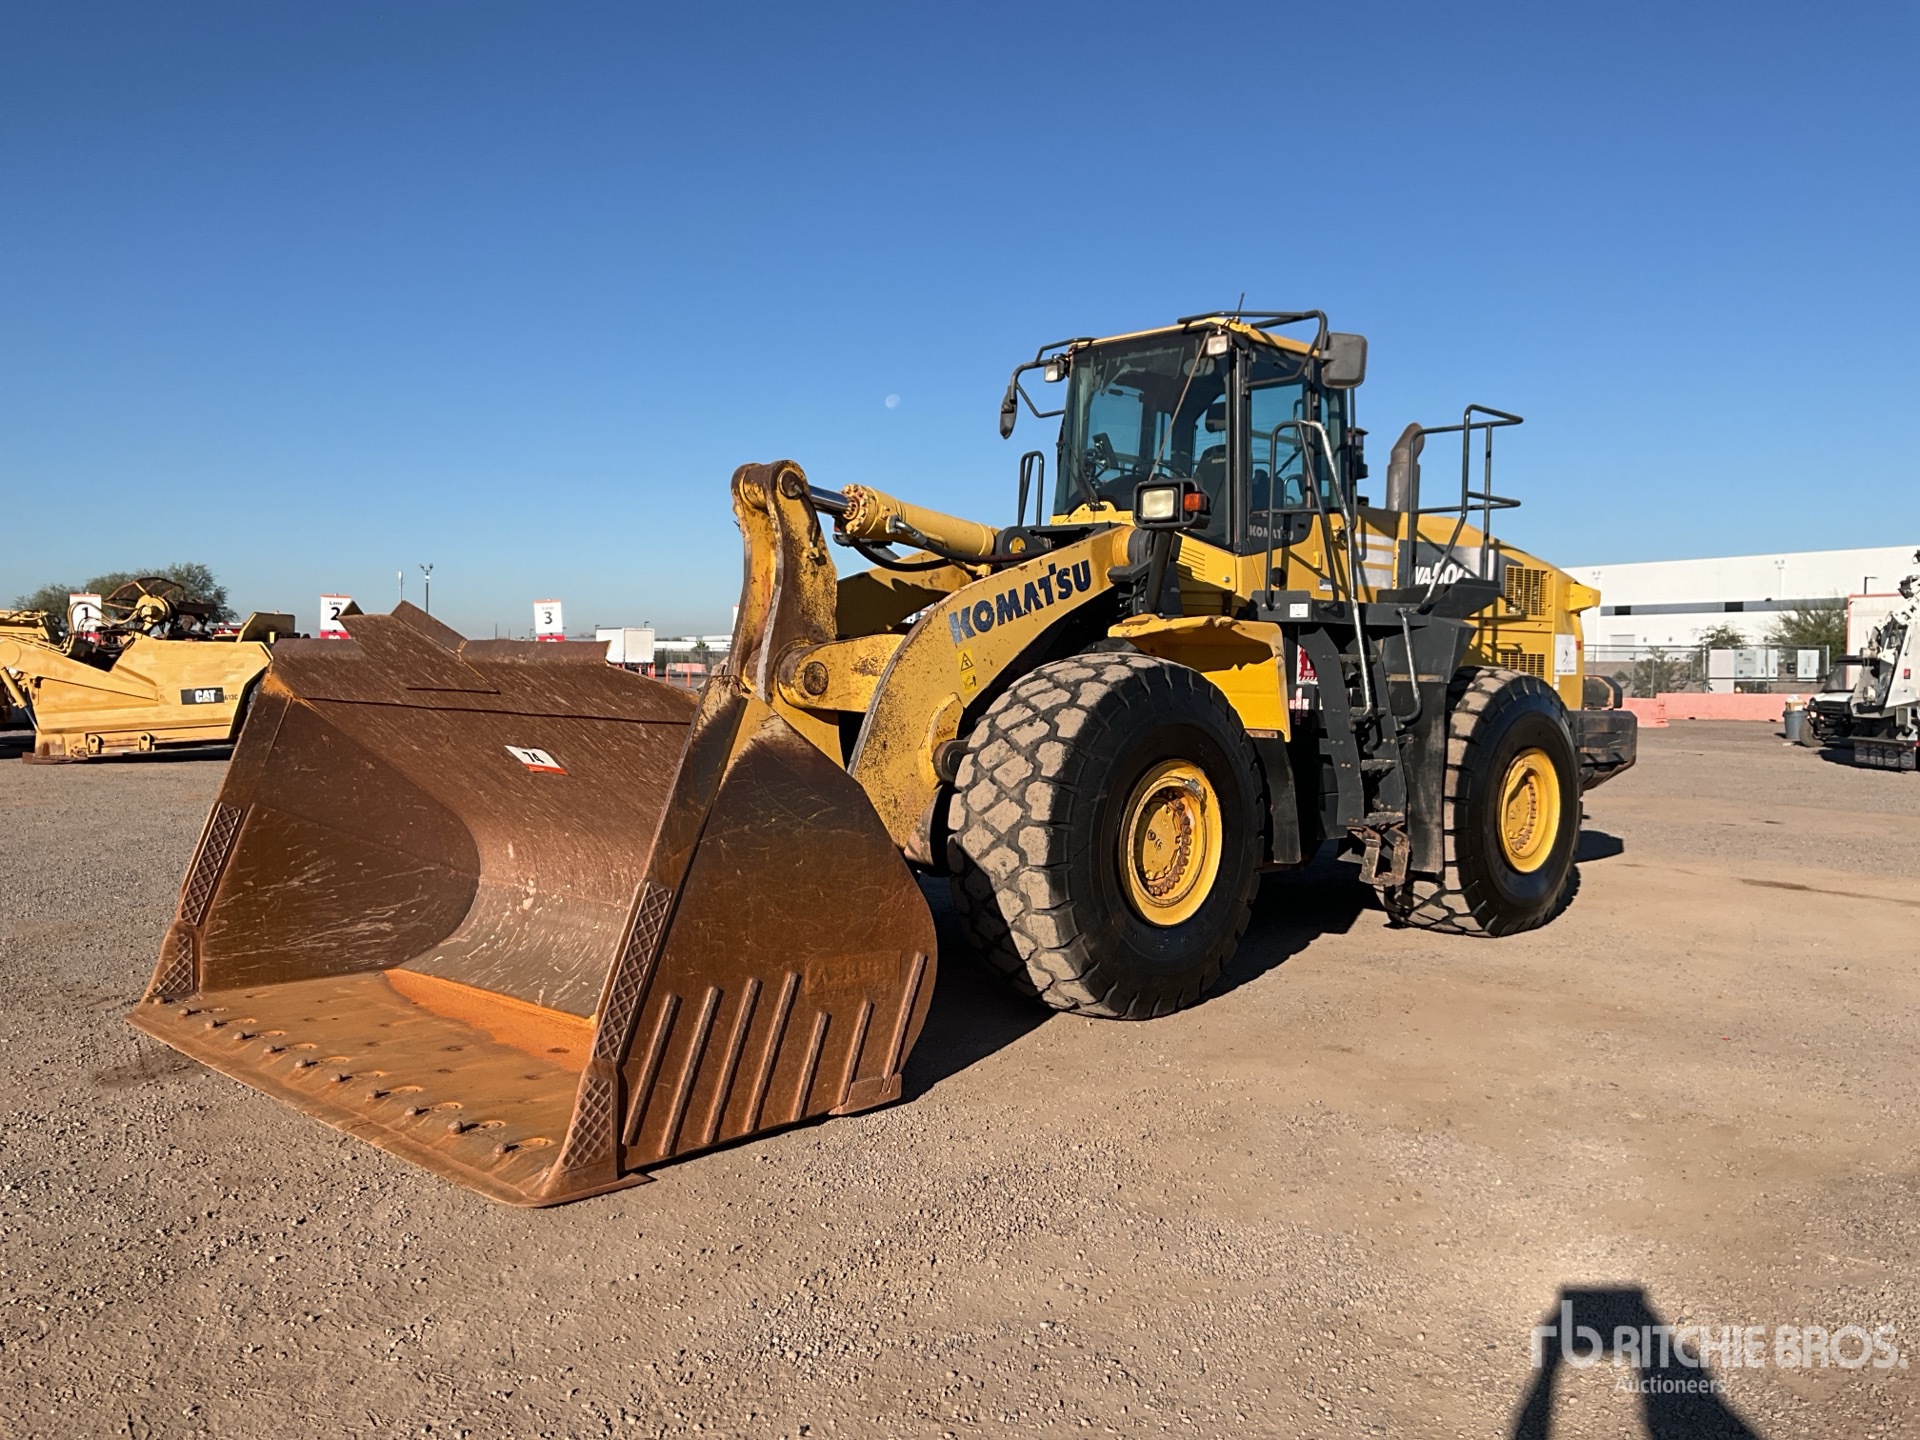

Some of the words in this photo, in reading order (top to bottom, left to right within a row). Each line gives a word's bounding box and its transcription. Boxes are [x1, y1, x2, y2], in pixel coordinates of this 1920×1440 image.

[949, 559, 1092, 645] KOMATSU
[82, 607, 89, 620] 1
[330, 606, 341, 621] 2
[544, 611, 553, 625] 3
[194, 689, 216, 703] CAT
[521, 750, 545, 764] 74
